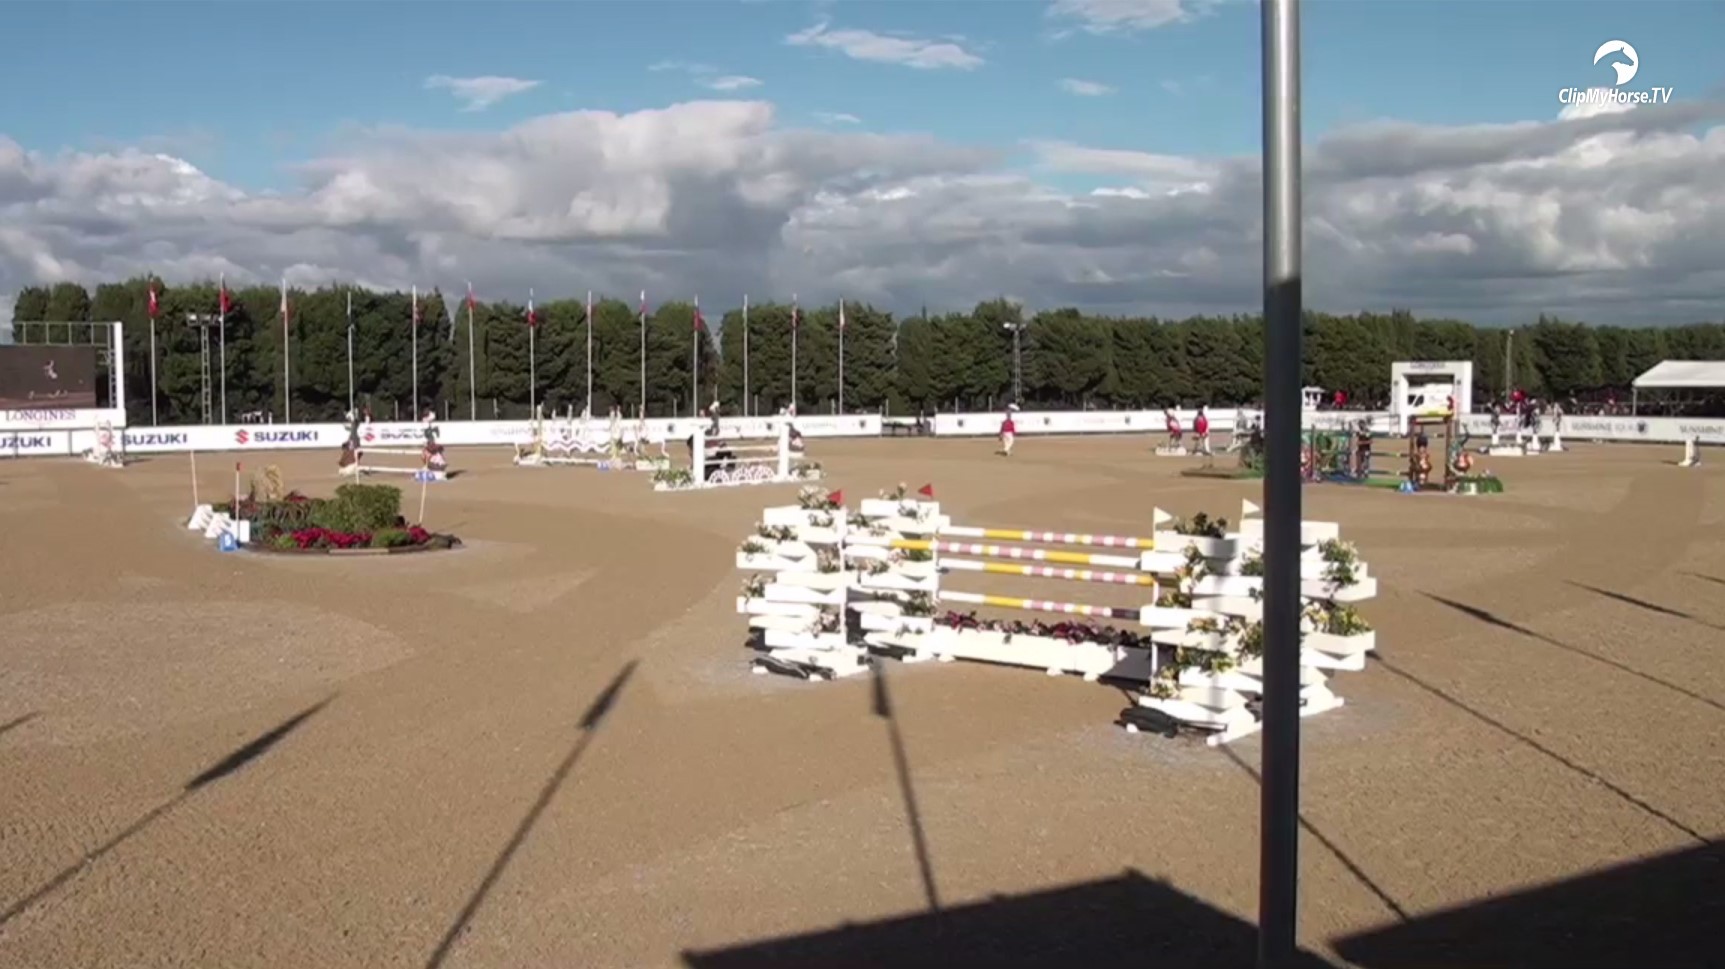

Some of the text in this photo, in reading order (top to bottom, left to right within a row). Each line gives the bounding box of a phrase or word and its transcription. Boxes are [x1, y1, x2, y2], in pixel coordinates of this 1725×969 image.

[5, 409, 76, 421] LONGINES
[121, 433, 188, 445] SUZUKI
[254, 431, 319, 442] SUZUKI
